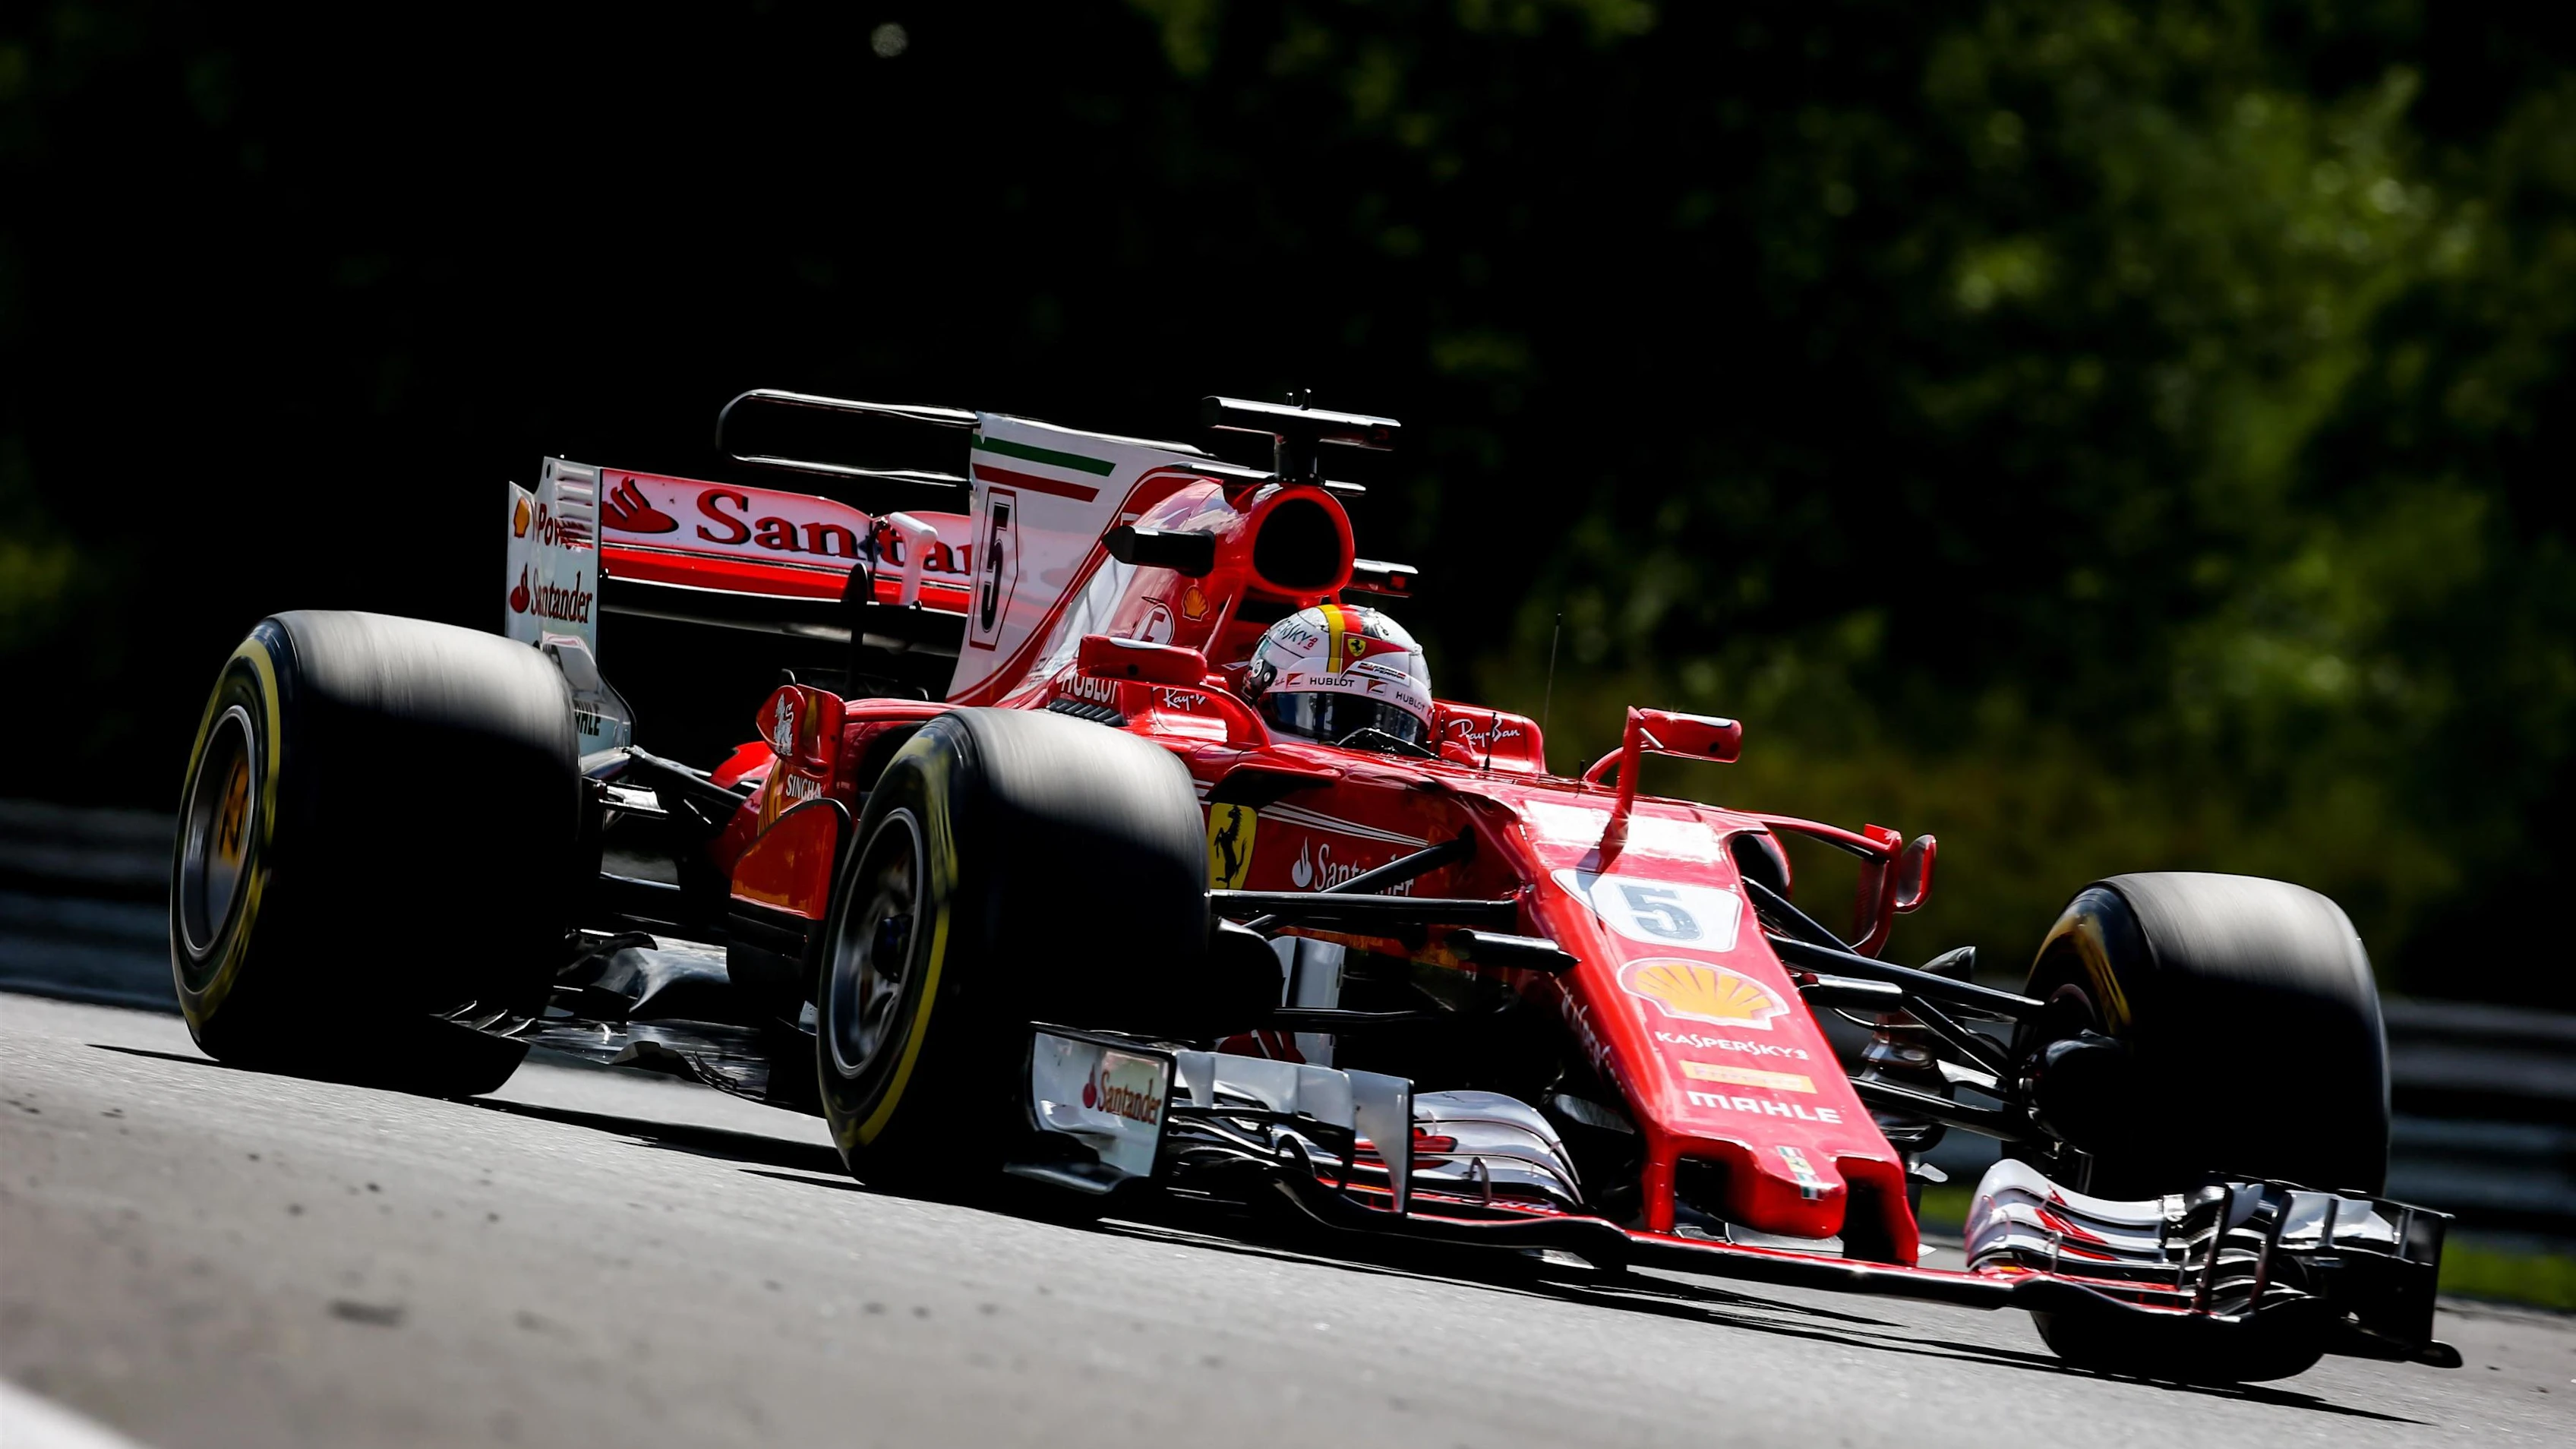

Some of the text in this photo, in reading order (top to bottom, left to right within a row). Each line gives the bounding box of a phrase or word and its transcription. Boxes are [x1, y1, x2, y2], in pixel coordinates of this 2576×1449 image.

[696, 488, 971, 576] Santa
[981, 501, 1010, 633] 5
[531, 568, 592, 623] Santander
[1310, 677, 1355, 687] HUBLOT
[1396, 691, 1425, 712] HUBLOT
[1448, 718, 1520, 748] Ray-Ban
[1615, 882, 1704, 942] 5
[1654, 1031, 1793, 1059] KASPERSKY
[1097, 1069, 1162, 1125] Santander
[1686, 1091, 1844, 1125] MAHLE
